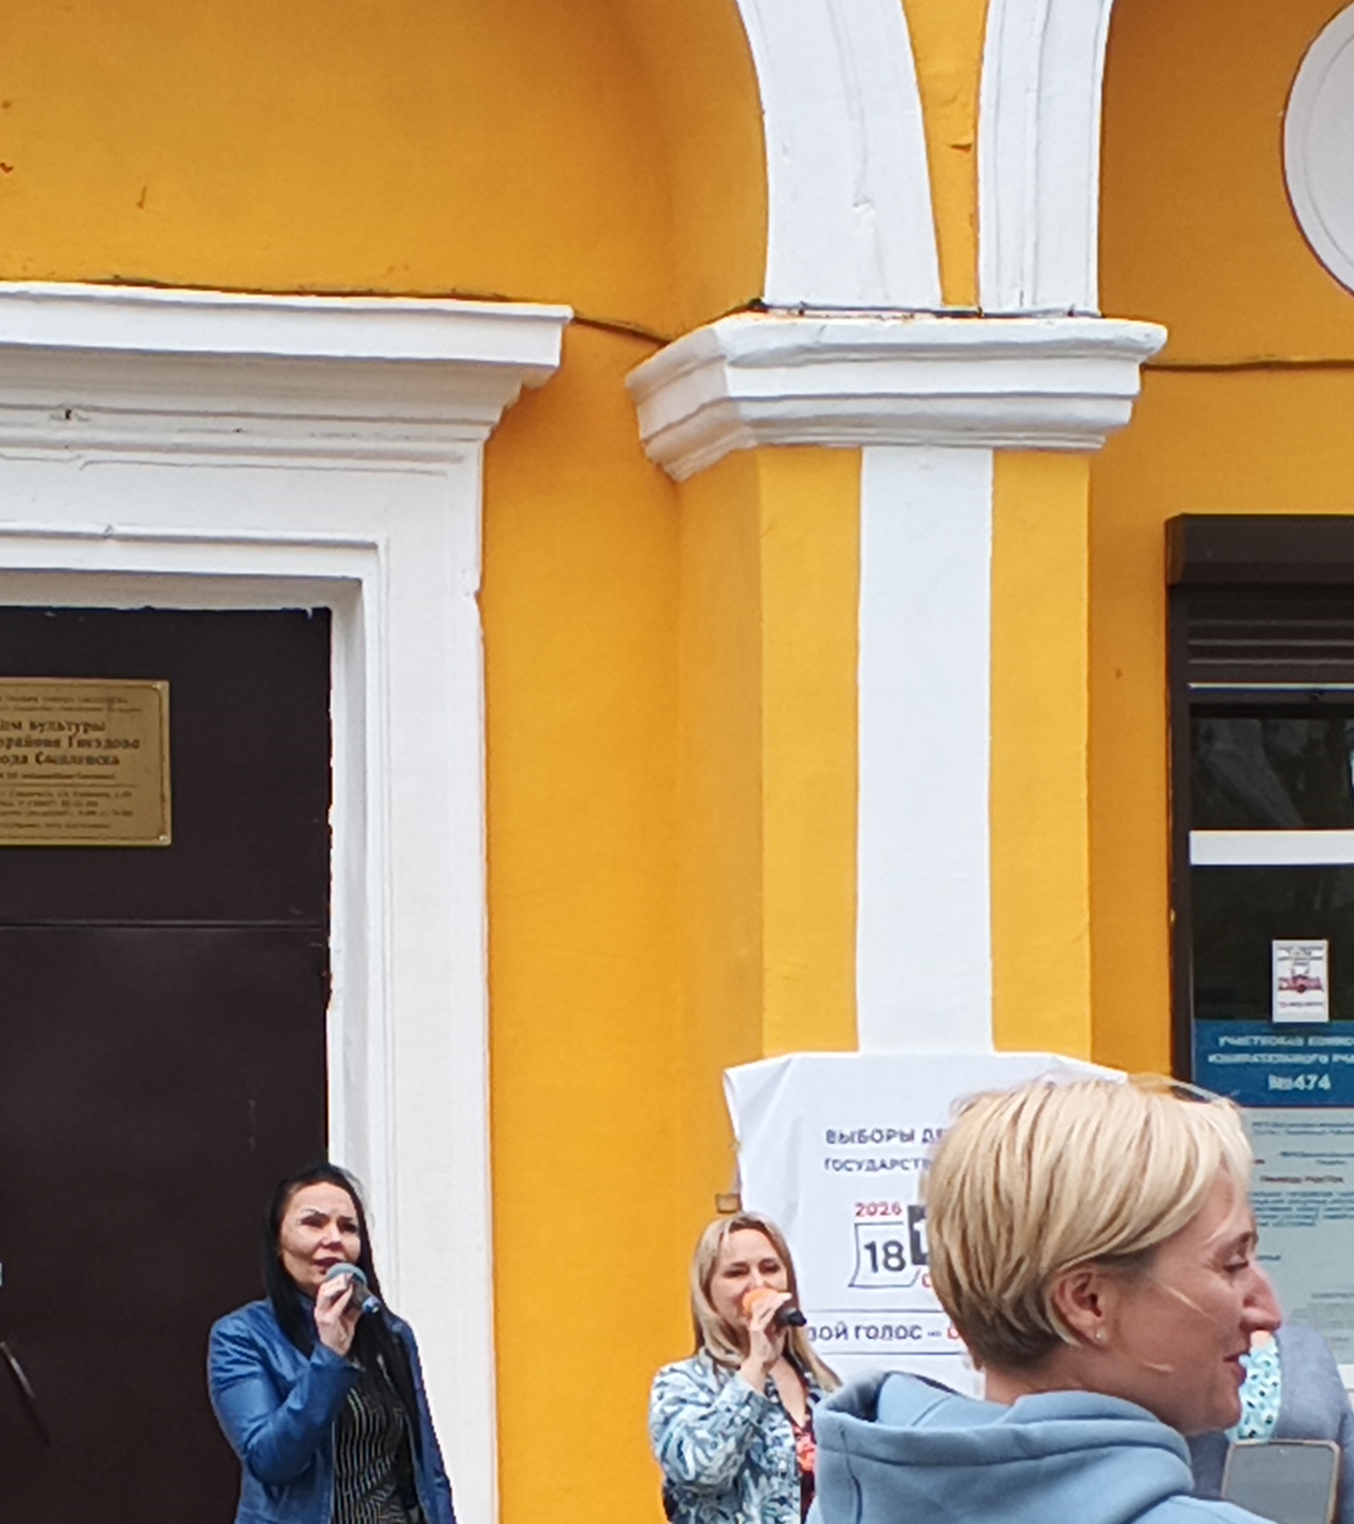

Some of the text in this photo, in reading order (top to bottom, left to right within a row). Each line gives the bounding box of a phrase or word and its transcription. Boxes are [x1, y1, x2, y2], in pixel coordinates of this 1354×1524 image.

[29, 719, 105, 736] культуры
[35, 751, 120, 766] Смоленска
[825, 1128, 915, 1145] ВЫБОРЫ
[855, 1201, 903, 1217] 2026
[864, 1240, 907, 1274] 18
